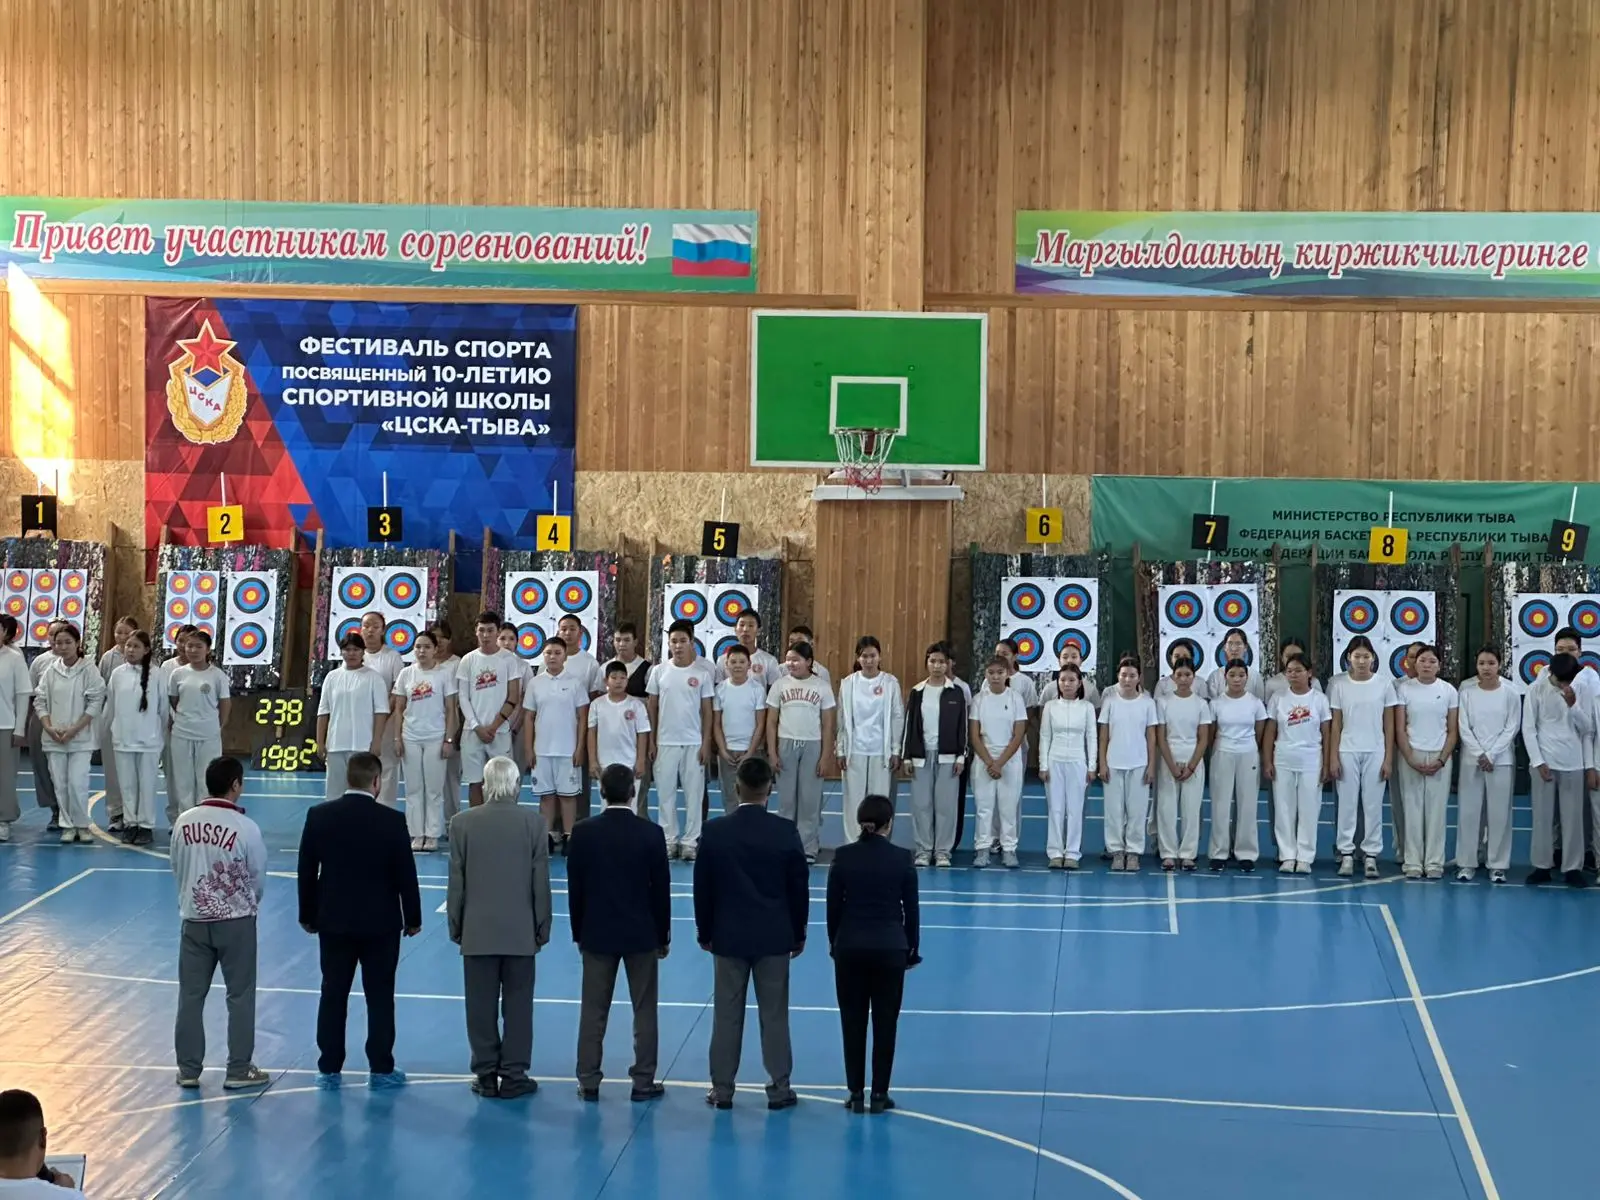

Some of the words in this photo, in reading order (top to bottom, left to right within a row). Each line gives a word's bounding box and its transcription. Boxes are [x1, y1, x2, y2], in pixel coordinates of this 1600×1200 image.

[12, 212, 152, 260] Привет
[165, 224, 387, 264] участникам
[399, 223, 651, 269] соревнований!
[1033, 231, 1283, 276] Маргылдааның
[1295, 242, 1588, 277] киржикчилеринге
[299, 336, 449, 358] ФЕСТИВАЛЬ
[454, 340, 552, 359] СПОРТА
[432, 365, 551, 385] 10-ЛЕТИЮ
[189, 386, 221, 411] ЦСКА
[281, 387, 448, 409] СПОРТИВНОЙ
[455, 391, 551, 410] ШКОЛЫ
[381, 415, 551, 436] «ЦСКА-ТЫВА»
[35, 501, 44, 525] 1
[219, 513, 231, 535] 2
[379, 512, 391, 536] 3
[1272, 510, 1379, 522] МИНИСТЕРСТВО
[1383, 511, 1473, 524] РЕСПУБЛИКИ
[1477, 513, 1516, 524] ТЫВА
[547, 522, 559, 545] 4
[1038, 514, 1050, 537] 6
[1204, 521, 1217, 544] 7
[1239, 528, 1320, 541] ФЕДЕРАЦИЯ
[1416, 531, 1507, 543] РЕСПУБЛИКИ
[1510, 532, 1549, 544] ТЫВА
[713, 527, 725, 550] 5
[1382, 534, 1395, 557] 8
[1561, 527, 1576, 552] 9
[1263, 547, 1344, 561] ФДЕРАЦИИ
[255, 698, 303, 726] 238
[261, 738, 318, 771] 1982
[182, 822, 238, 852] RUSSIA
